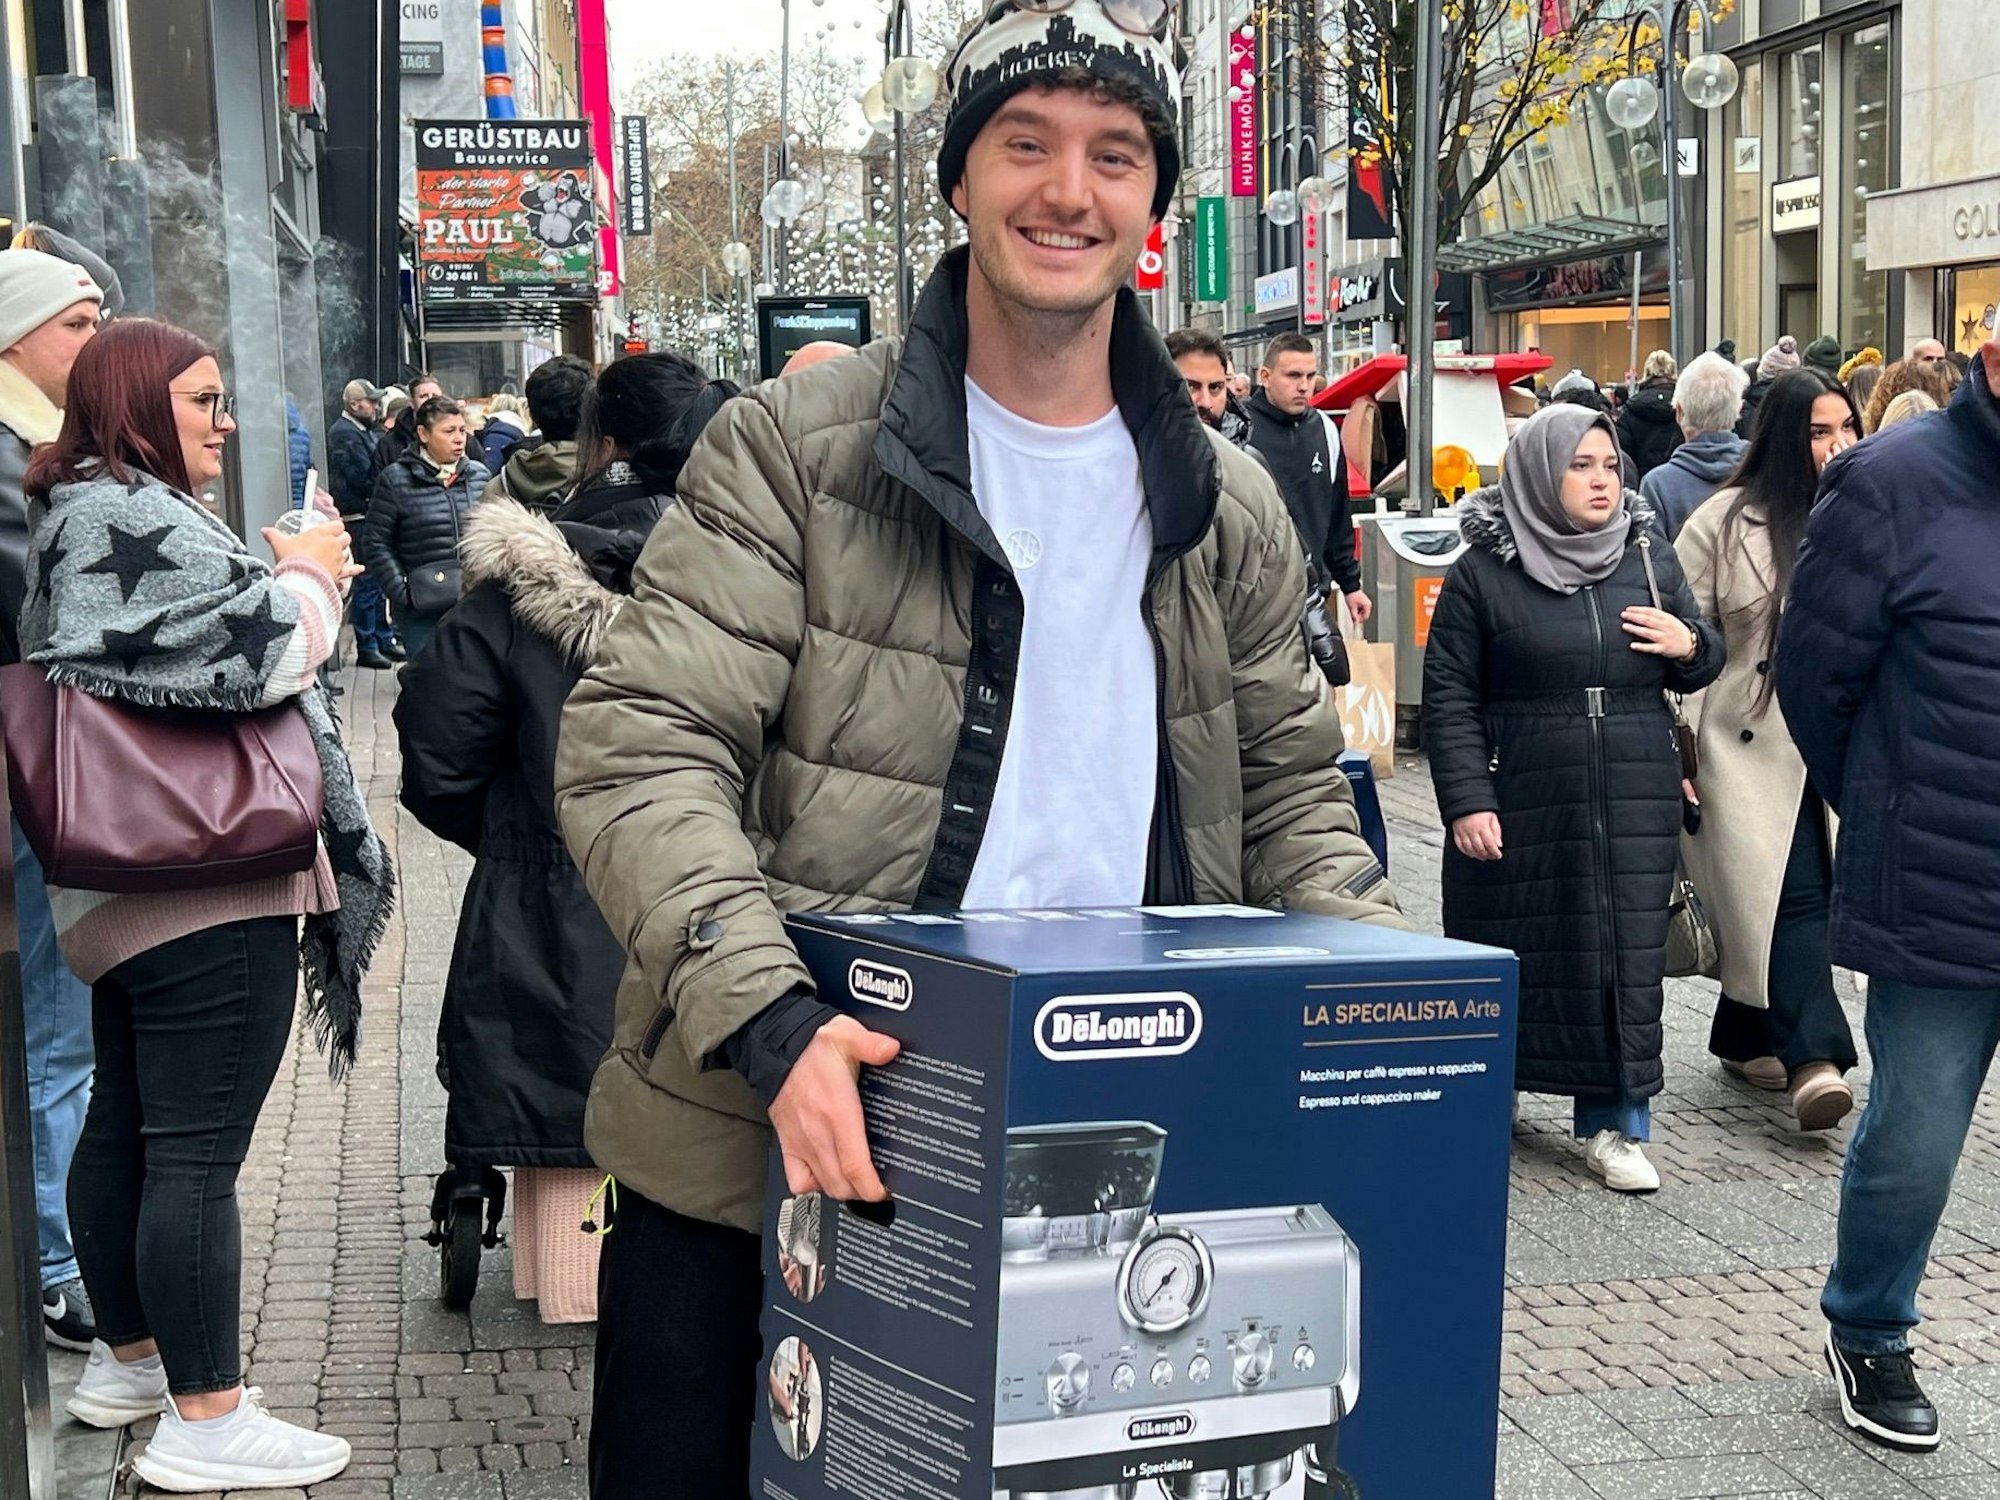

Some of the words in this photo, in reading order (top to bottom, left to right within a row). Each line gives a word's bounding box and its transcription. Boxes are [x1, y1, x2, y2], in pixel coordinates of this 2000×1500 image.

[401, 4, 439, 19] CING
[400, 55, 431, 69] TAGE
[999, 50, 1096, 83] HOCKEY
[422, 122, 581, 149] GERÜSTBAU
[1238, 68, 1254, 186] HUNKEMÖLLR
[454, 151, 549, 165] Bauservice
[628, 119, 643, 183] SUPERDRY
[468, 176, 509, 188] starke
[439, 194, 505, 209] Partner!
[424, 219, 514, 244] PAUL
[1953, 202, 2000, 240] GOL
[1303, 1005, 1330, 1026] LA
[1335, 1000, 1459, 1024] SPECIALISTA
[1463, 999, 1500, 1019] Arte
[1300, 1068, 1345, 1083] Macchina
[1346, 1069, 1362, 1083] per
[1363, 1065, 1387, 1079] caffè
[1388, 1065, 1426, 1079] espresso
[1428, 1067, 1436, 1076] e
[1436, 1061, 1487, 1077] cappuccino
[1299, 1096, 1341, 1111] Espresso
[1342, 1093, 1359, 1106] and
[1360, 1091, 1412, 1106] cappuccino
[1413, 1088, 1442, 1101] maker
[1123, 1465, 1137, 1478] La
[1139, 1458, 1194, 1477] Specialista
